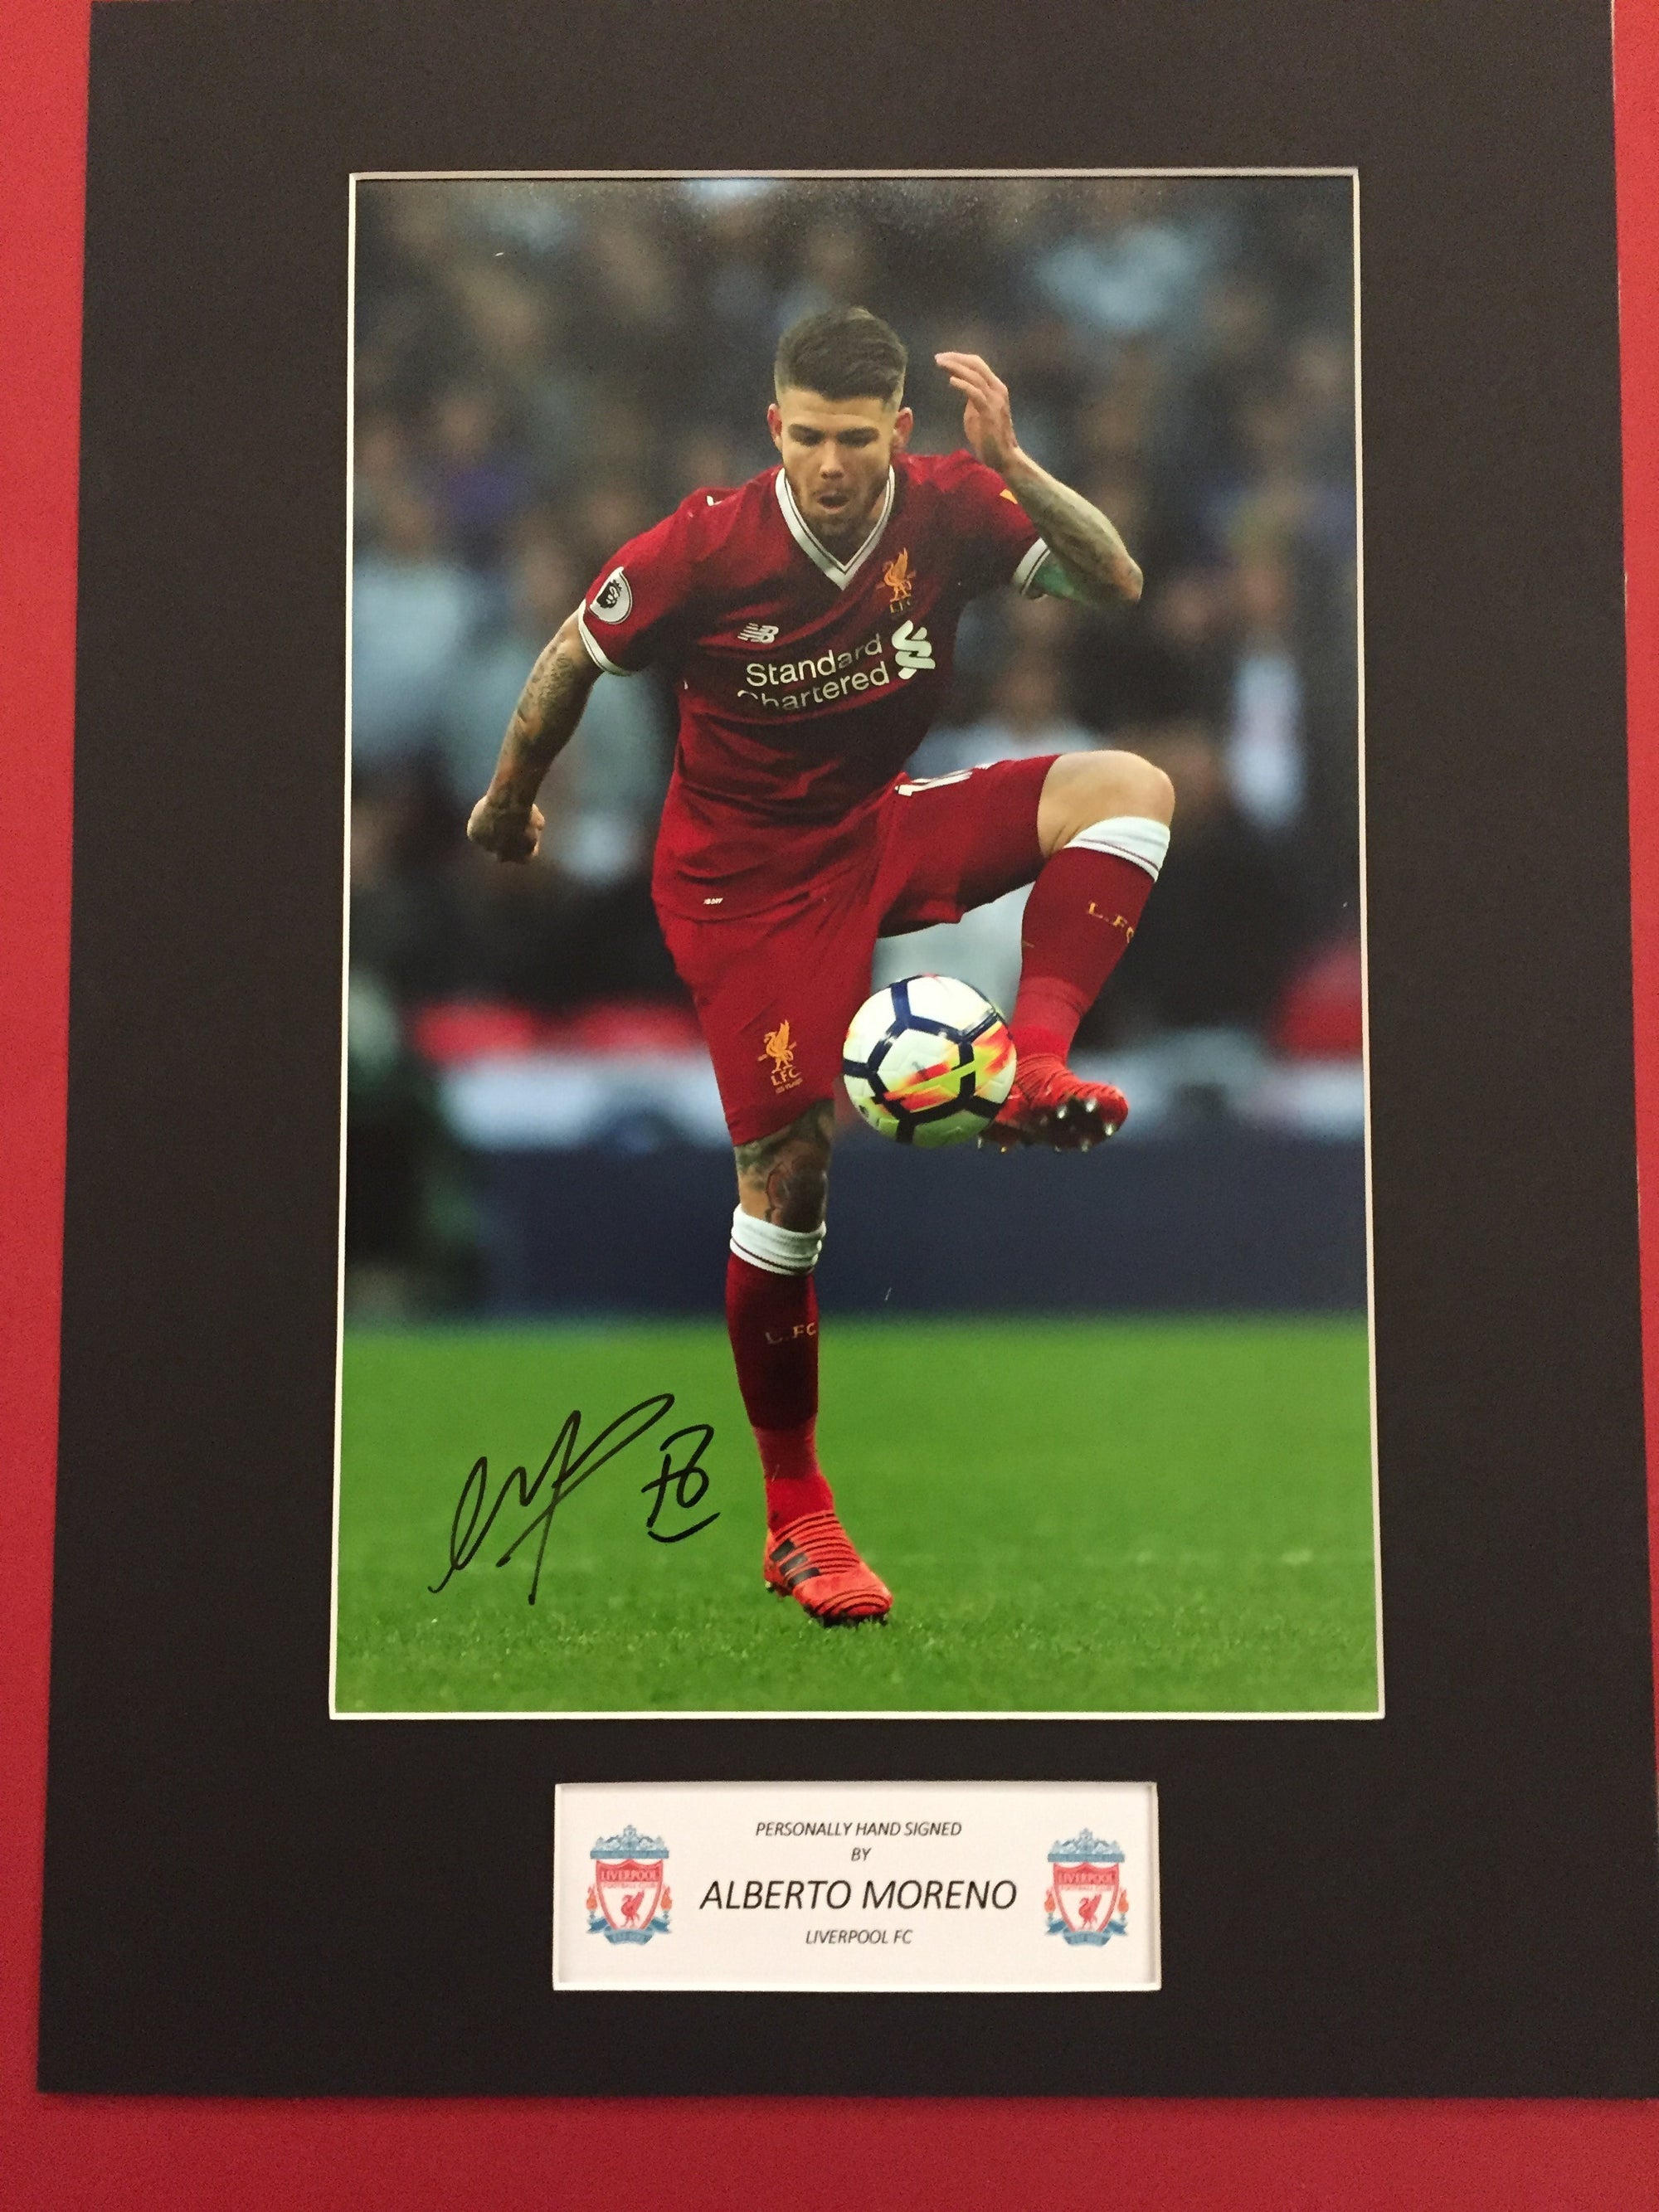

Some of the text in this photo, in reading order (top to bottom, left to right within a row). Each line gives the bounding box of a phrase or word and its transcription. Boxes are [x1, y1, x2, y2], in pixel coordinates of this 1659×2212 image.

[746, 633, 883, 687] Standard
[755, 1821, 962, 1837] PERSONALLY HAND SIGNED
[850, 1847, 872, 1862] BY
[601, 1870, 658, 1880] LIVERPOOL
[698, 1879, 1018, 1910] ALBERTO MORENO
[805, 1929, 913, 1945] LIVERPOOL FC
